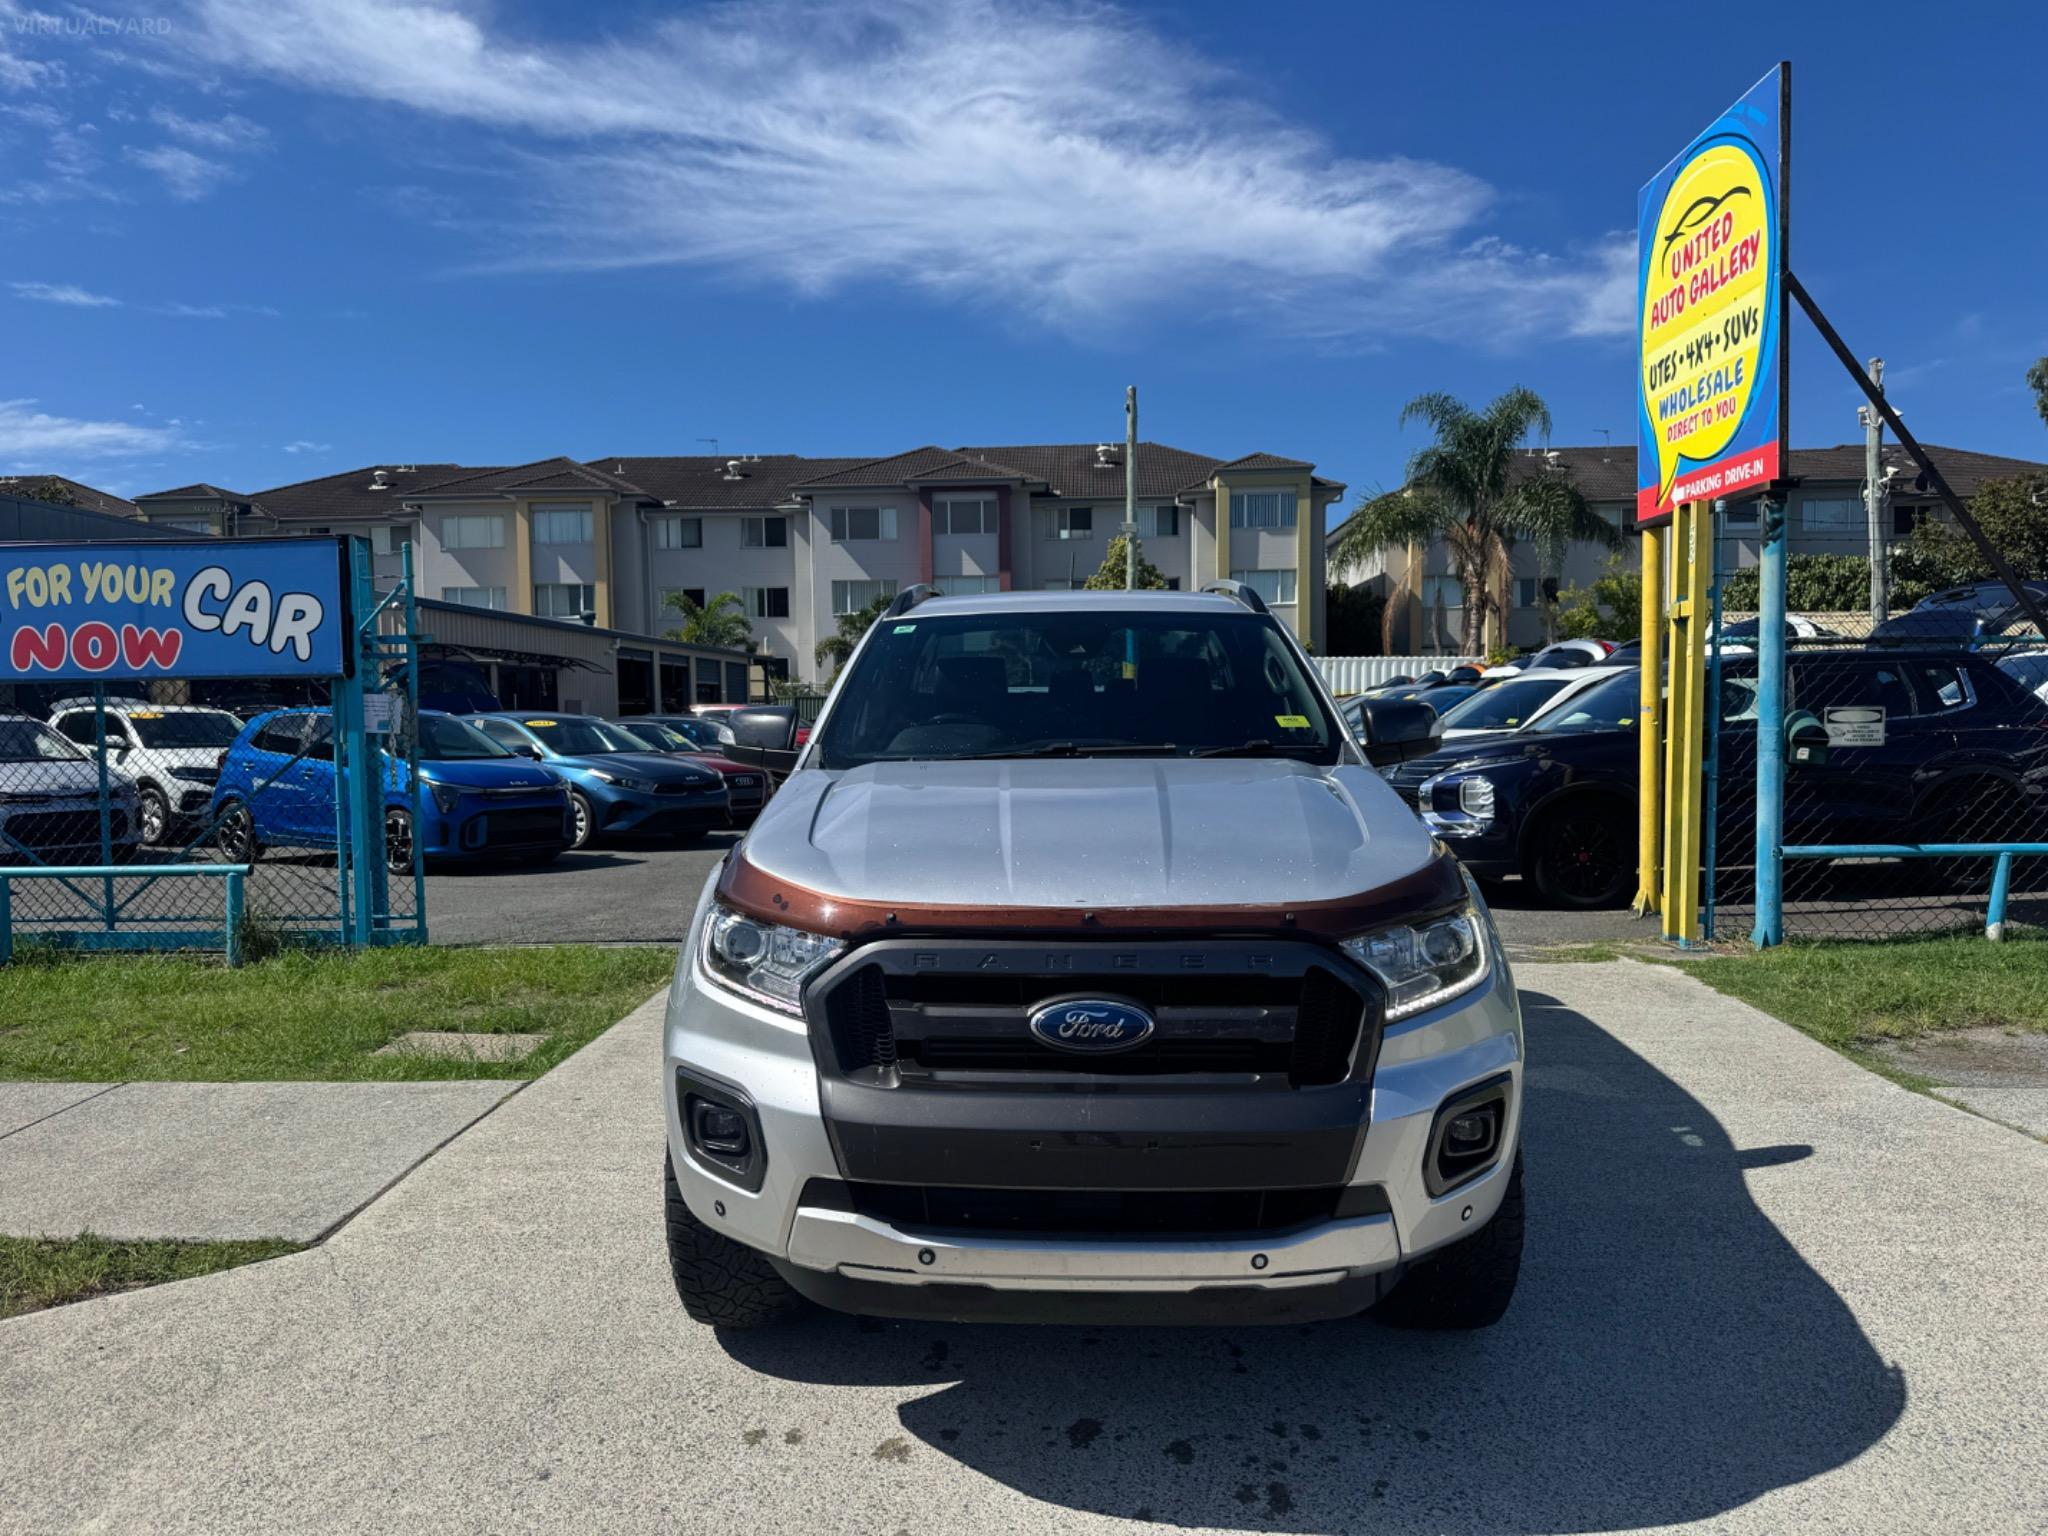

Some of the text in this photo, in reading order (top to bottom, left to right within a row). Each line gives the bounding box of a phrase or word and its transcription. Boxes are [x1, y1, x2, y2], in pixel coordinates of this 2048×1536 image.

[1671, 211, 1733, 280] UNITED
[1650, 228, 1761, 330] AUTO GALLERY
[1658, 356, 1743, 422] WHOLESALE
[1667, 396, 1736, 443] DIRECT TO YOU
[1685, 457, 1764, 499] PARKING DRIVE-IN
[6, 561, 324, 662] FOR YOUR CAR
[10, 621, 183, 672] NOW
[1058, 1009, 1125, 1039] Ford
